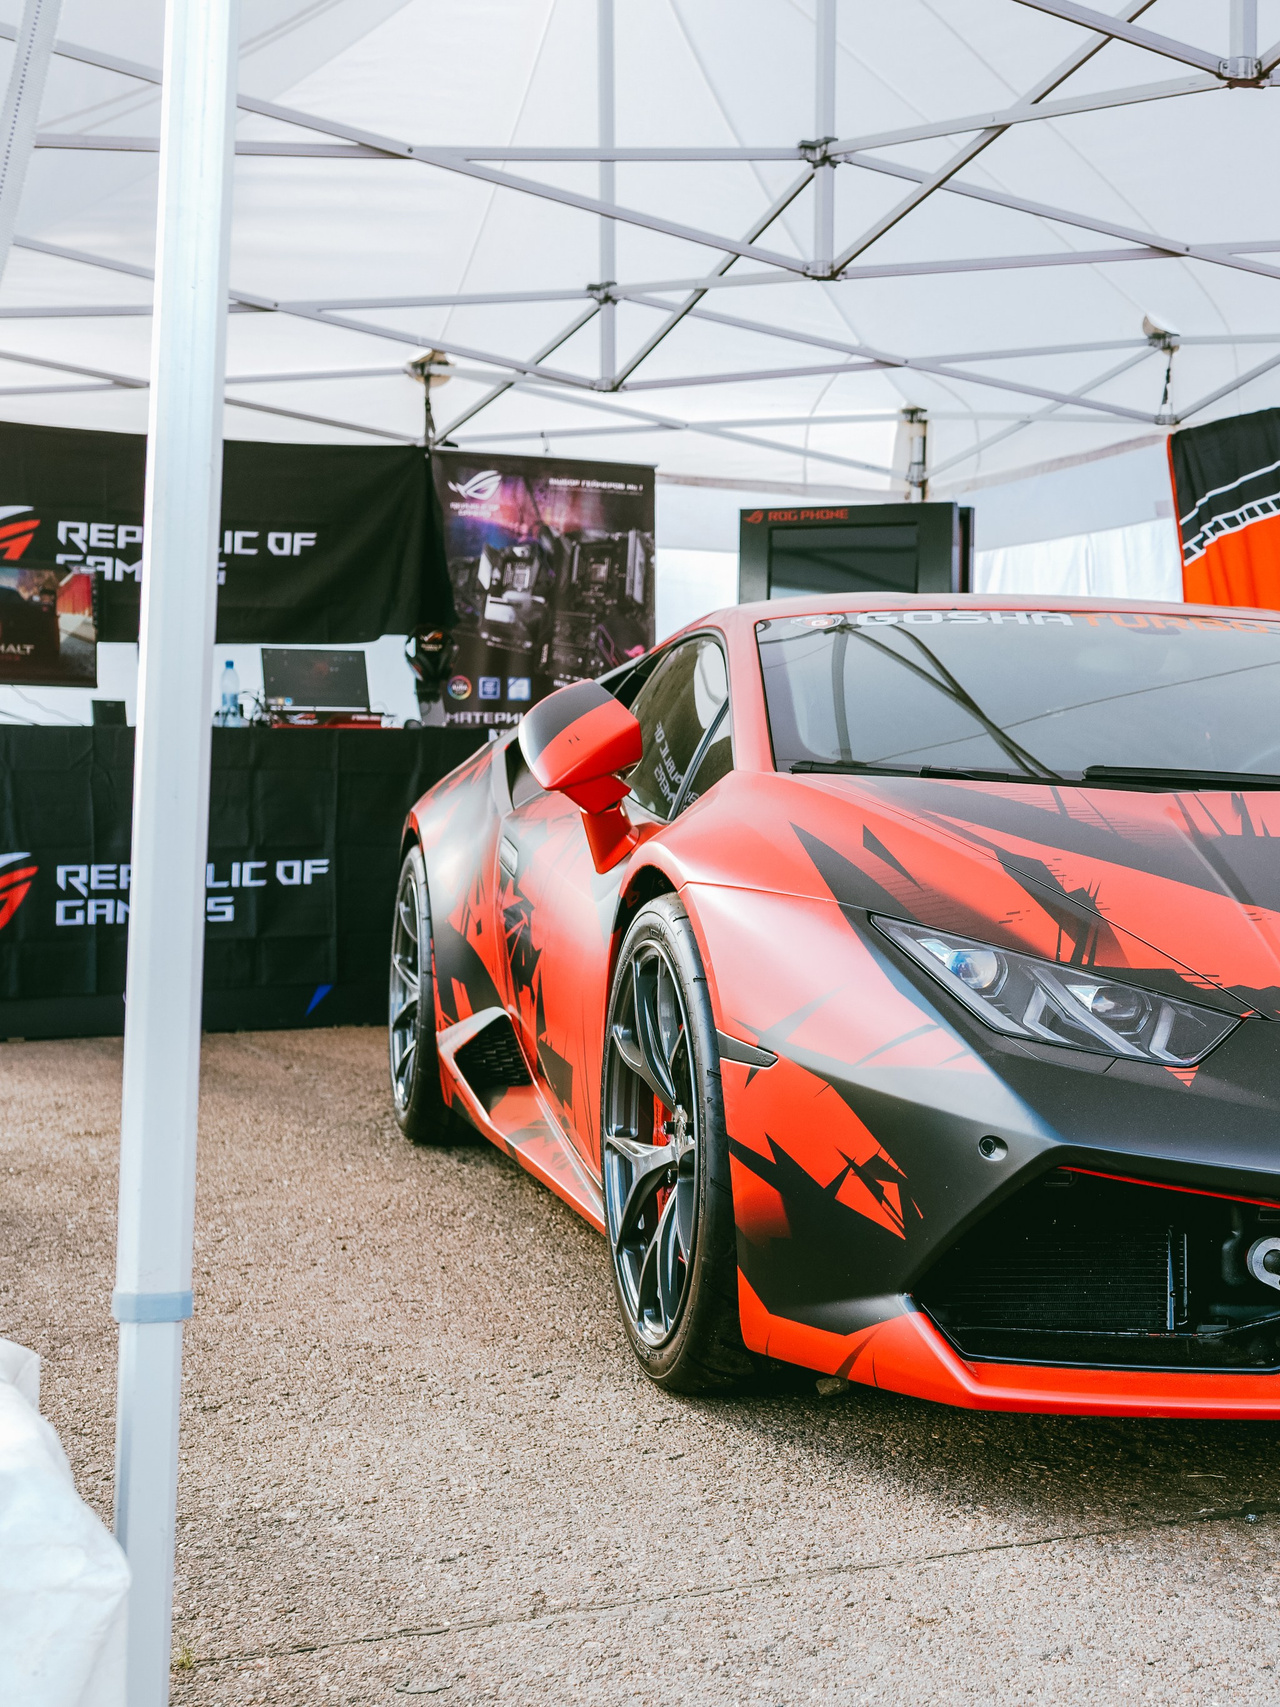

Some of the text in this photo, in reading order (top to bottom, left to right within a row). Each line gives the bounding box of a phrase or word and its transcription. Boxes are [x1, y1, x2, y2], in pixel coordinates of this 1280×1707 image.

[768, 508, 848, 521] ROG PHONE
[267, 531, 318, 556] OF
[857, 611, 1074, 627] GOSHA
[276, 858, 330, 886] OF
